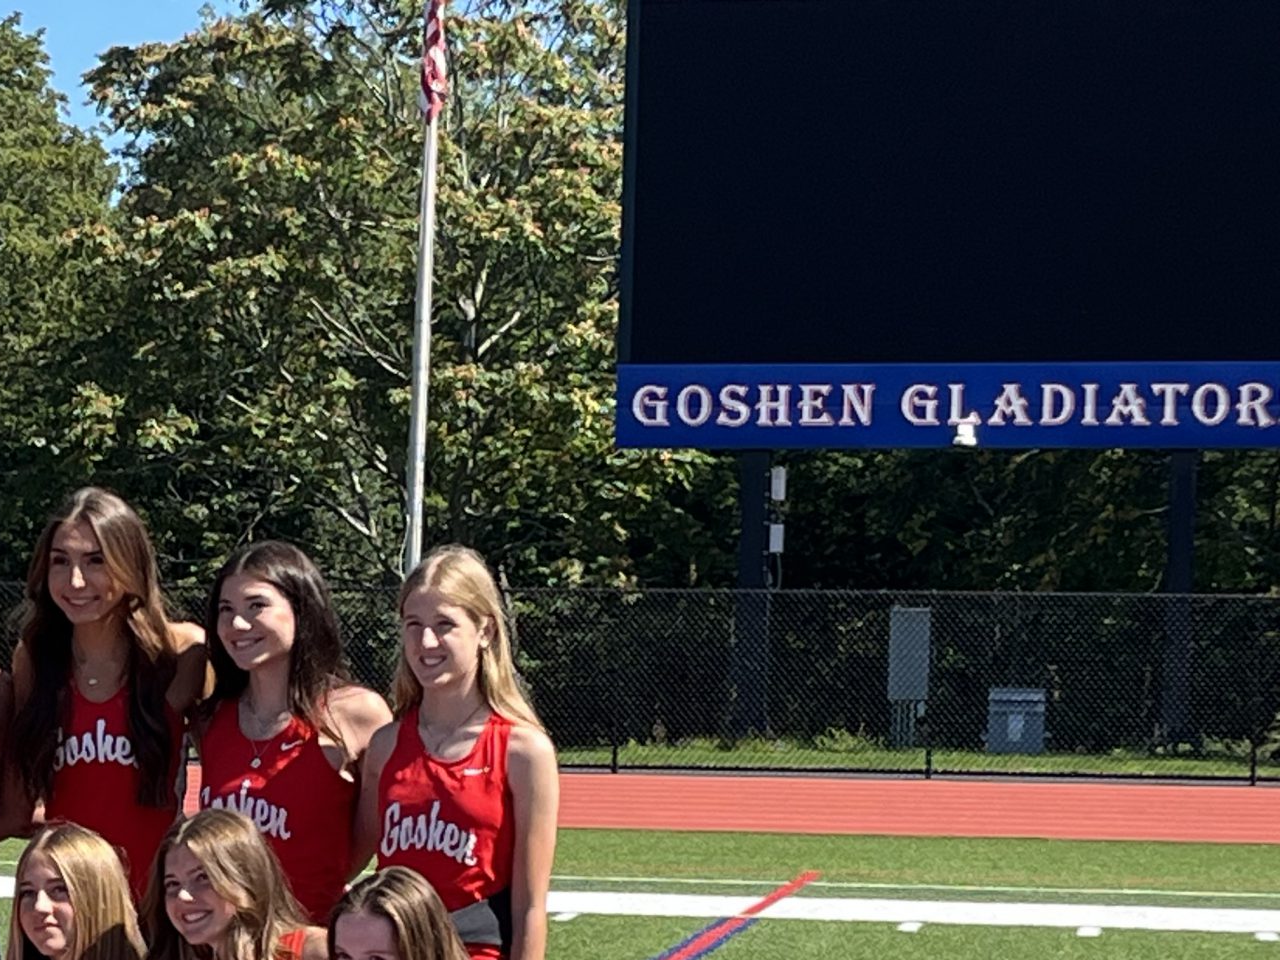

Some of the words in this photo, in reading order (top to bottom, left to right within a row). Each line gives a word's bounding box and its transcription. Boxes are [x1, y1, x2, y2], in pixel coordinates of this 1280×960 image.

[632, 383, 877, 426] GOSHEN
[901, 383, 1280, 426] GLADIATOR
[380, 800, 478, 867] Goshen
